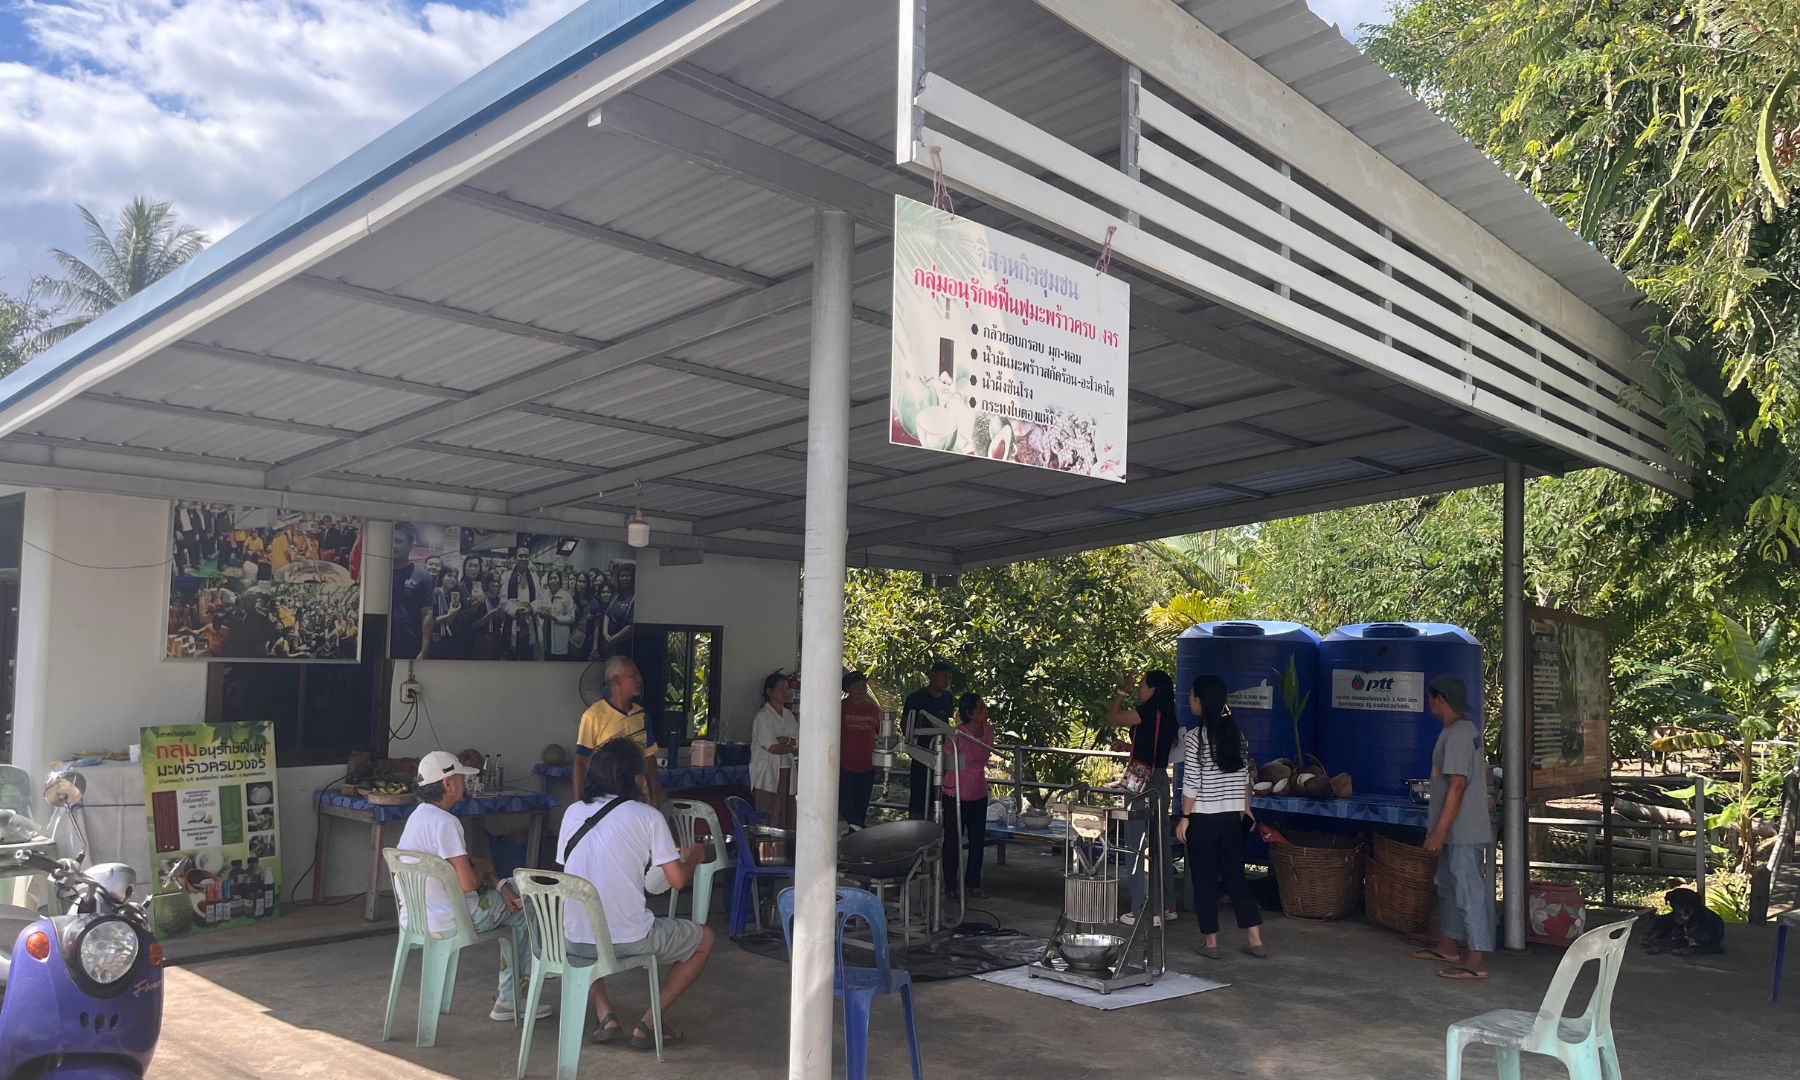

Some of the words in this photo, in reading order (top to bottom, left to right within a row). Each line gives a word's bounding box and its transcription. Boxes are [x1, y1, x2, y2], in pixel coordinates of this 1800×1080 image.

[976, 239, 1080, 301] วิสาหกิจชุมชน
[983, 324, 1045, 354] กล้วยอบกรอบ
[982, 345, 1115, 397] น้ำมันมะพร้าวสกัดร้อน-อะโวคาโด
[982, 370, 1034, 400] น้ำผึ้งชันโรง
[981, 399, 1055, 426] กระทงใบตองแห้ง
[1366, 677, 1394, 691] ptt
[158, 758, 266, 776] มะพร้าวครบวงจร
